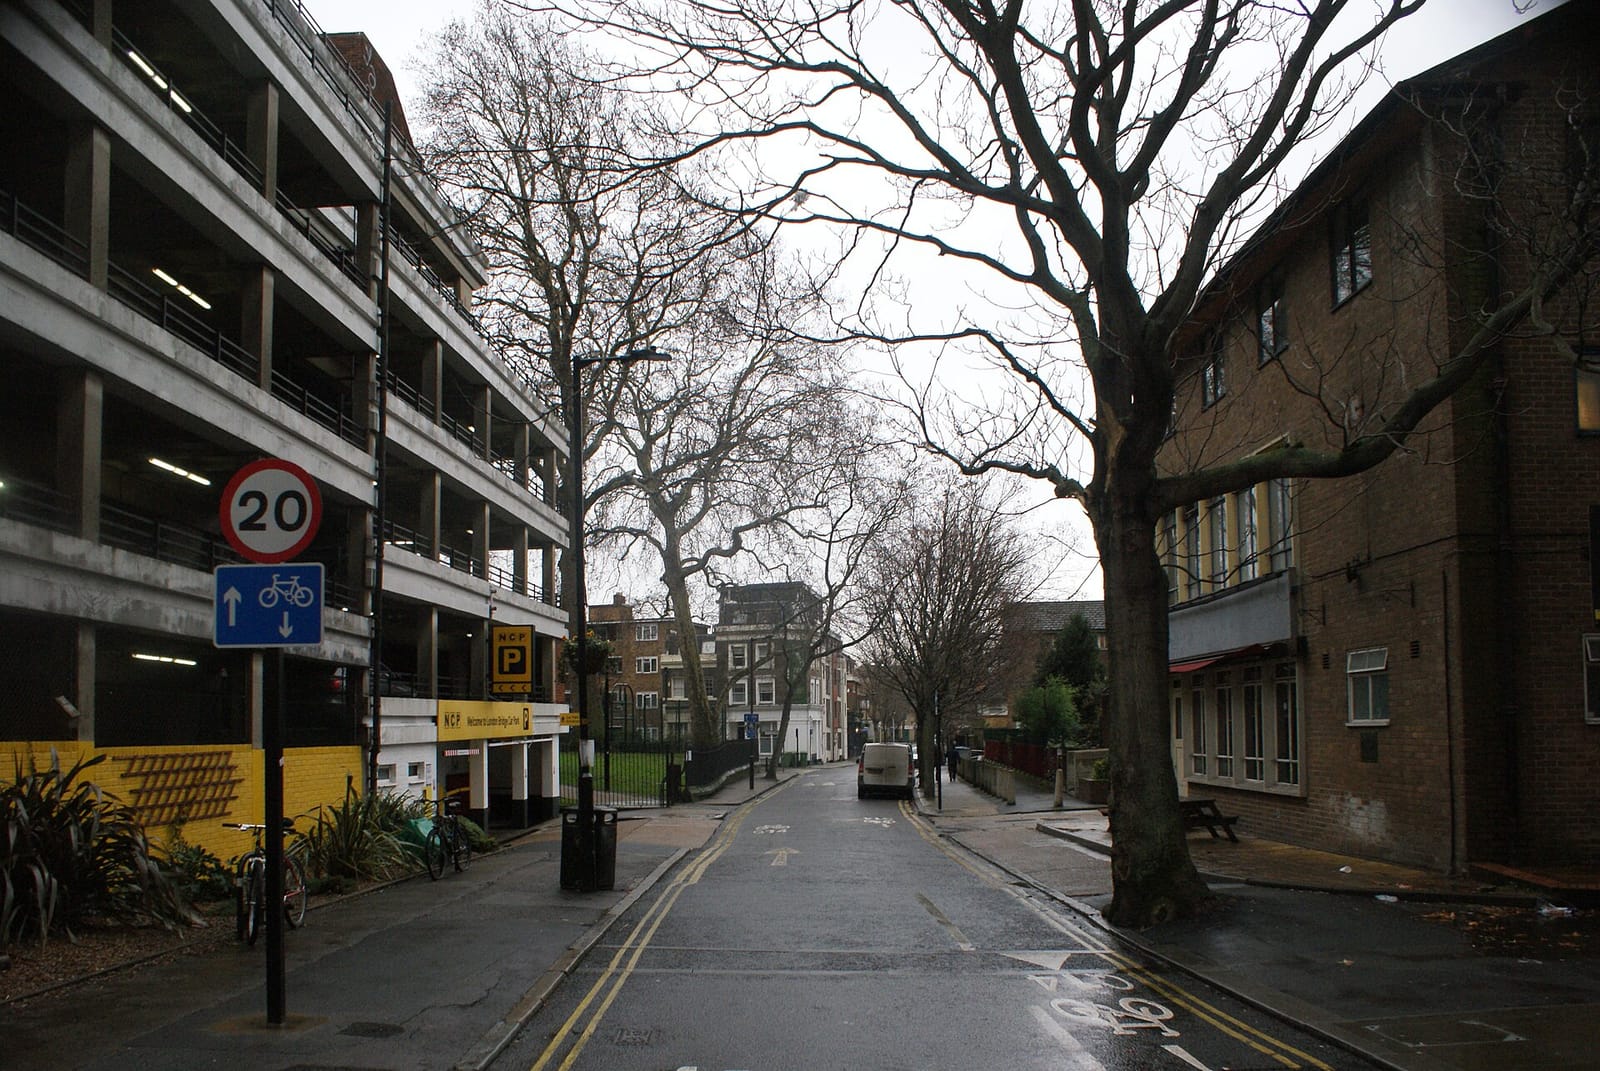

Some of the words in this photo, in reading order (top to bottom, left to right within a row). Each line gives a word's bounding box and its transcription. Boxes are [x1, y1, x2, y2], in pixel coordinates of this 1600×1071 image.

[238, 490, 307, 532] 20
[499, 633, 526, 641] NCP
[504, 649, 521, 673] P
[445, 713, 461, 728] NCP
[467, 716, 482, 726] Welcome
[486, 716, 498, 726] London
[498, 716, 508, 728] Bridge
